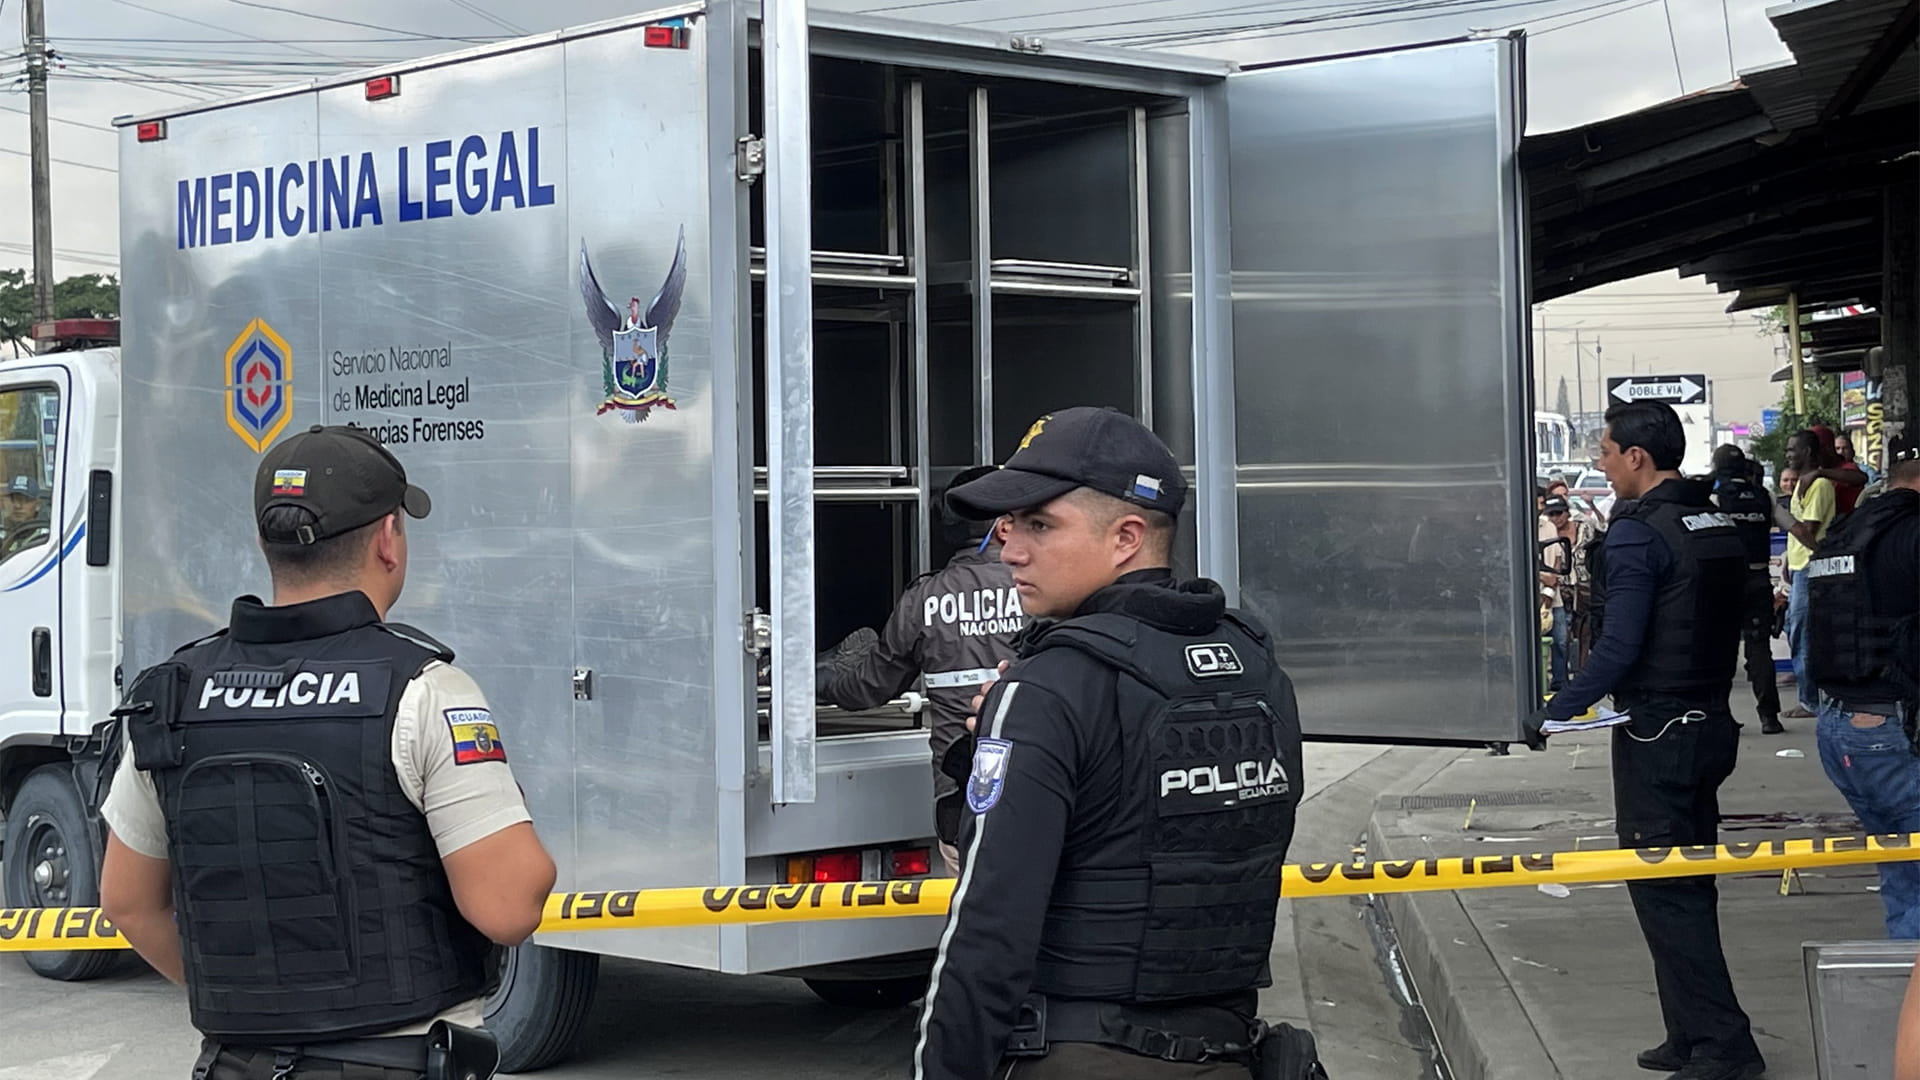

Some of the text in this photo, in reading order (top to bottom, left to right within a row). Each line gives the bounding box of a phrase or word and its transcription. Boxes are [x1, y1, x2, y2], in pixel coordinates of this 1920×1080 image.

[178, 126, 555, 250] MEDICINA LEGAL
[332, 341, 452, 376] Servicio Nacional
[333, 376, 469, 412] de Medicina Legal
[1629, 385, 1683, 396] DOBLE VIA
[413, 418, 484, 443] Forenses
[924, 587, 1023, 626] POLICIA
[1160, 757, 1288, 798] POLICIA
[1238, 783, 1289, 800] ECUADOR
